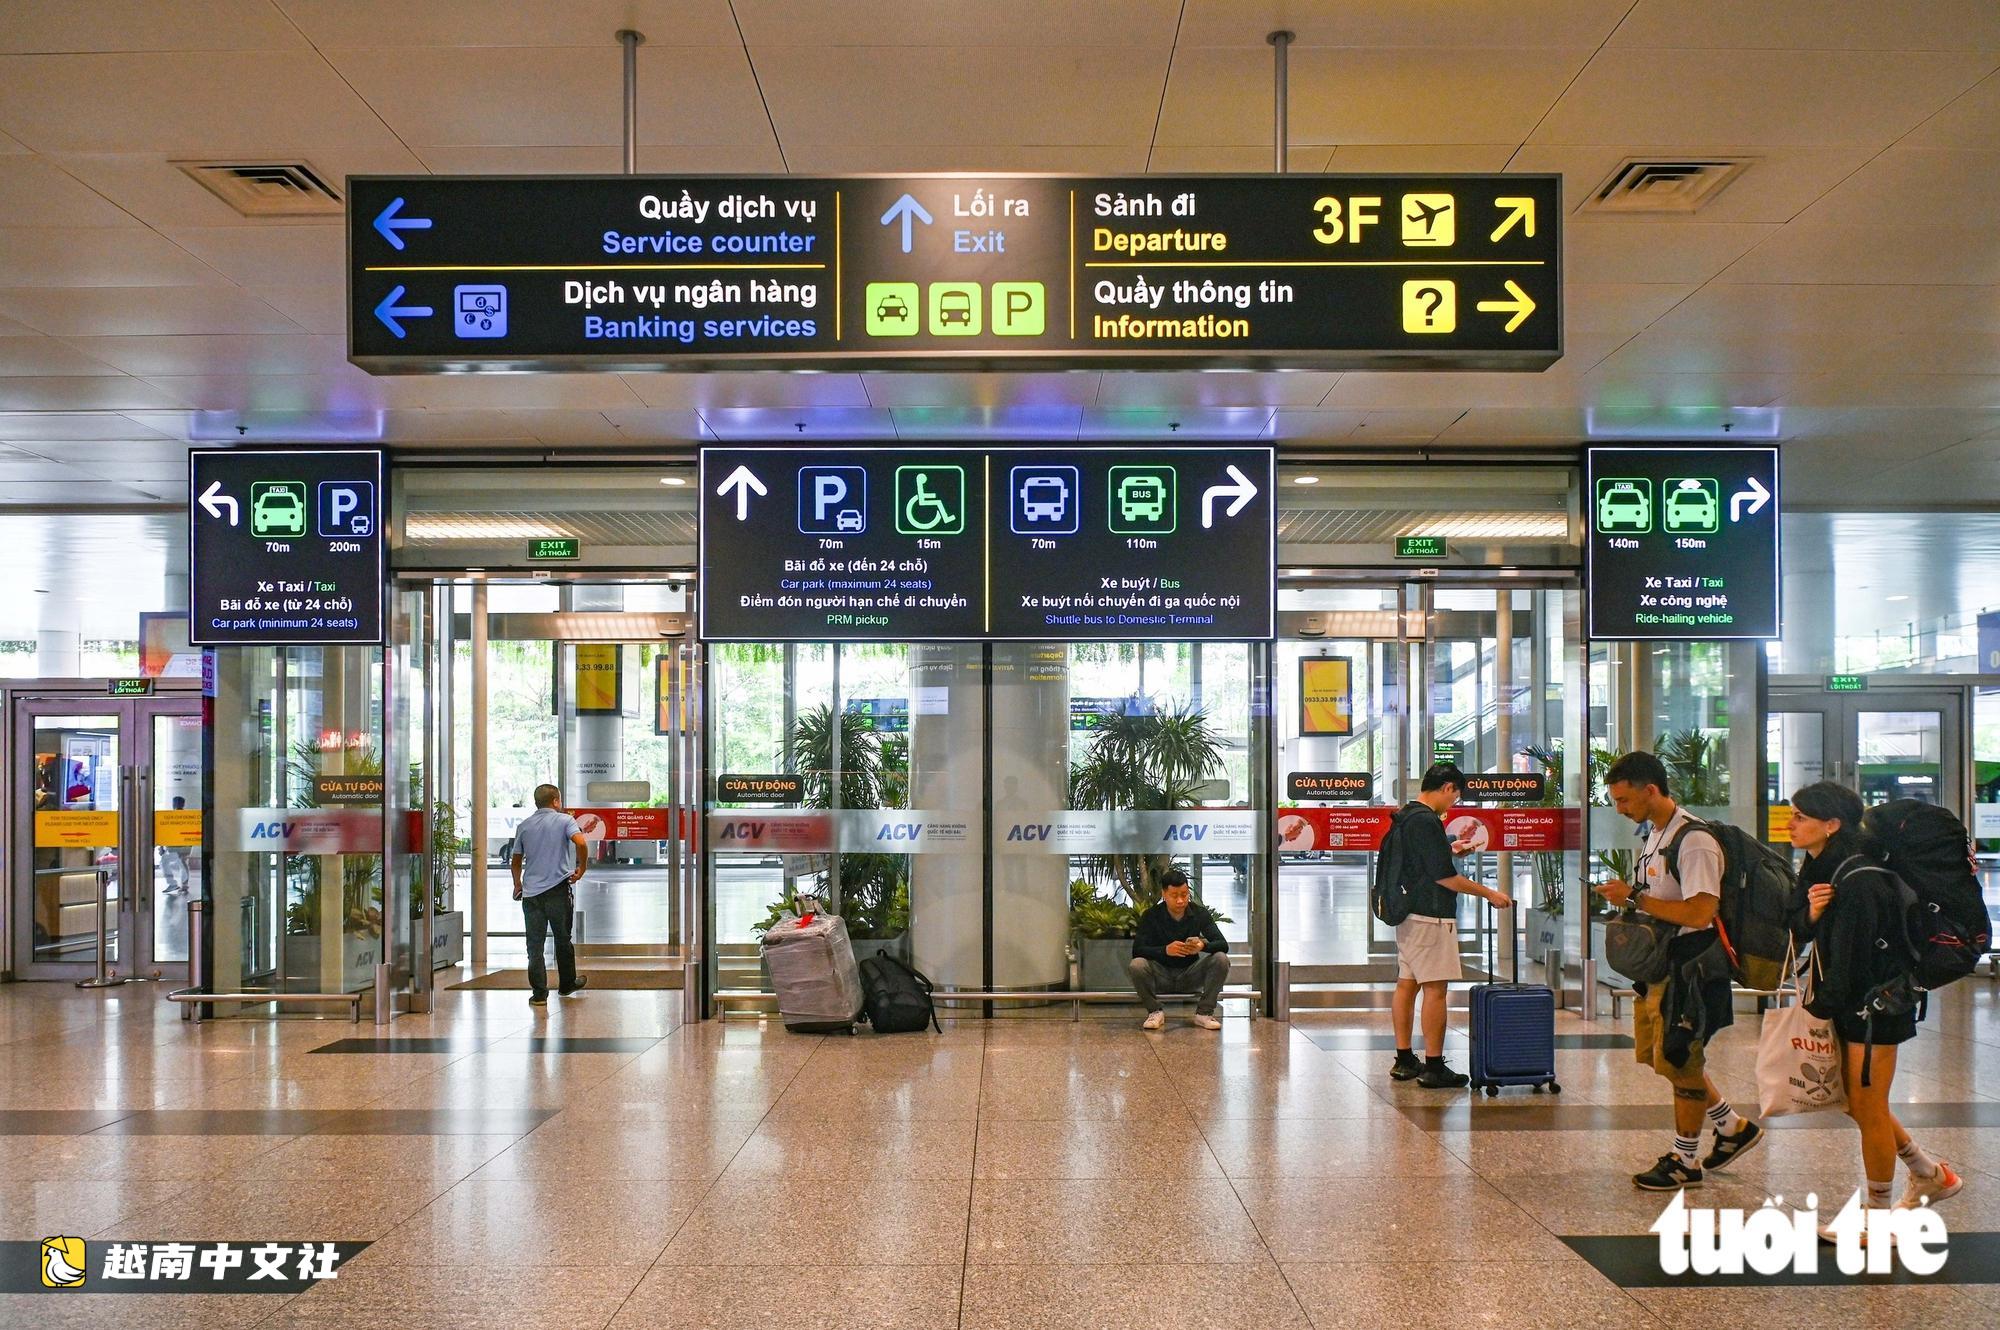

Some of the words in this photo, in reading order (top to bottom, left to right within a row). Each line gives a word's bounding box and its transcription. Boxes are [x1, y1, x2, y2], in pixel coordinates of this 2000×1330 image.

[639, 190, 710, 223] Quầy
[718, 195, 776, 223] dịch
[784, 201, 817, 223] vụ
[953, 190, 994, 217] Lối
[1003, 199, 1030, 217] ra
[1094, 193, 1162, 217] Sảnh
[1171, 193, 1196, 217] đi
[1313, 197, 1381, 244] 3F
[602, 231, 702, 254] Service
[711, 234, 815, 253] counter
[954, 231, 1005, 253] Exit
[1093, 229, 1227, 254] Departure
[564, 280, 626, 307] Dịch
[633, 286, 665, 309] vụ
[674, 281, 743, 309] ngân
[749, 281, 817, 308] hàng
[1094, 275, 1165, 309] Quầy
[1172, 280, 1251, 309] thông
[1259, 281, 1294, 304] tin
[584, 316, 695, 342] Banking
[703, 316, 816, 338] services
[1093, 314, 1249, 338] Information
[1132, 490, 1151, 498] BUS
[266, 542, 290, 552] 70m
[330, 542, 360, 552] 200m
[819, 539, 843, 549] 70m
[917, 539, 941, 549] 15m
[1032, 539, 1056, 549] 70m
[1126, 539, 1157, 549] 110m
[1408, 539, 1433, 547] EXIT
[1609, 538, 1639, 548] 140m
[1675, 538, 1706, 548] 150m
[785, 560, 805, 572] Bãi
[810, 558, 825, 572] đỗ
[830, 563, 844, 572] xe
[848, 558, 876, 573] (đến
[880, 561, 895, 571] 24
[899, 558, 927, 573] chỗ)
[258, 581, 274, 592] Xe
[278, 581, 304, 592] Taxi
[307, 581, 312, 592] /
[314, 582, 336, 592] Taxi
[781, 580, 799, 588] Car
[803, 580, 824, 591] park
[828, 580, 881, 590] (maximum
[884, 580, 896, 588] 24
[900, 580, 932, 590] seats)
[1101, 578, 1118, 588] Xe
[1122, 578, 1150, 591] buýt
[1153, 578, 1158, 589] /
[1161, 579, 1180, 588] Bus
[1646, 577, 1662, 588] Xe
[1665, 577, 1692, 588] Taxi
[1695, 577, 1699, 588] /
[1702, 578, 1723, 587] Taxi
[221, 600, 240, 610] Bãi
[245, 597, 261, 610] đỗ
[265, 602, 280, 610] xe
[284, 600, 302, 612] (từ
[306, 600, 320, 610] 24
[324, 597, 352, 612] chỗ)
[740, 595, 774, 607] Điểm
[778, 594, 801, 607] đón
[806, 594, 845, 610] người
[849, 596, 873, 610] hạn
[878, 593, 900, 607] chế
[904, 596, 915, 607] di
[920, 594, 966, 610] chuyển
[1022, 596, 1038, 607] Xe
[1042, 596, 1071, 610] buýt
[1074, 593, 1094, 607] nối
[1098, 593, 1145, 610] chuyến
[1149, 596, 1161, 607] đi
[1165, 599, 1180, 610] ga
[1184, 593, 1217, 610] quốc
[1220, 594, 1240, 609] nội
[1641, 595, 1657, 606] Xe
[1660, 595, 1692, 608] công
[1695, 595, 1727, 609] nghệ
[212, 619, 230, 628] Car
[234, 619, 256, 630] park
[259, 618, 308, 629] (minimum
[311, 619, 323, 628] 24
[327, 618, 357, 629] seats)
[827, 615, 852, 624] PRM
[856, 615, 889, 627] pickup
[1046, 615, 1081, 624] Shuttle
[1084, 615, 1102, 624] bus
[1106, 616, 1115, 624] to
[1119, 615, 1165, 624] Domestic
[1169, 615, 1213, 624] Terminal
[1636, 614, 1694, 625] Ride-hailing
[1698, 614, 1732, 623] vehicle
[320, 780, 342, 792] CỬA
[360, 781, 382, 793] ĐỘN
[726, 780, 748, 790] CỬA
[766, 780, 796, 792] ĐỘNG
[1295, 778, 1316, 788] CỬA
[1334, 778, 1365, 790] ĐỘNG
[1468, 779, 1489, 789] CỬA
[1506, 779, 1537, 790] ĐỘNG
[251, 823, 295, 838] ACV
[720, 823, 765, 839] ACV
[877, 824, 922, 840] ACV
[1007, 825, 1051, 840] ACV
[1163, 825, 1208, 840] ACV
[356, 950, 374, 968] ACV
